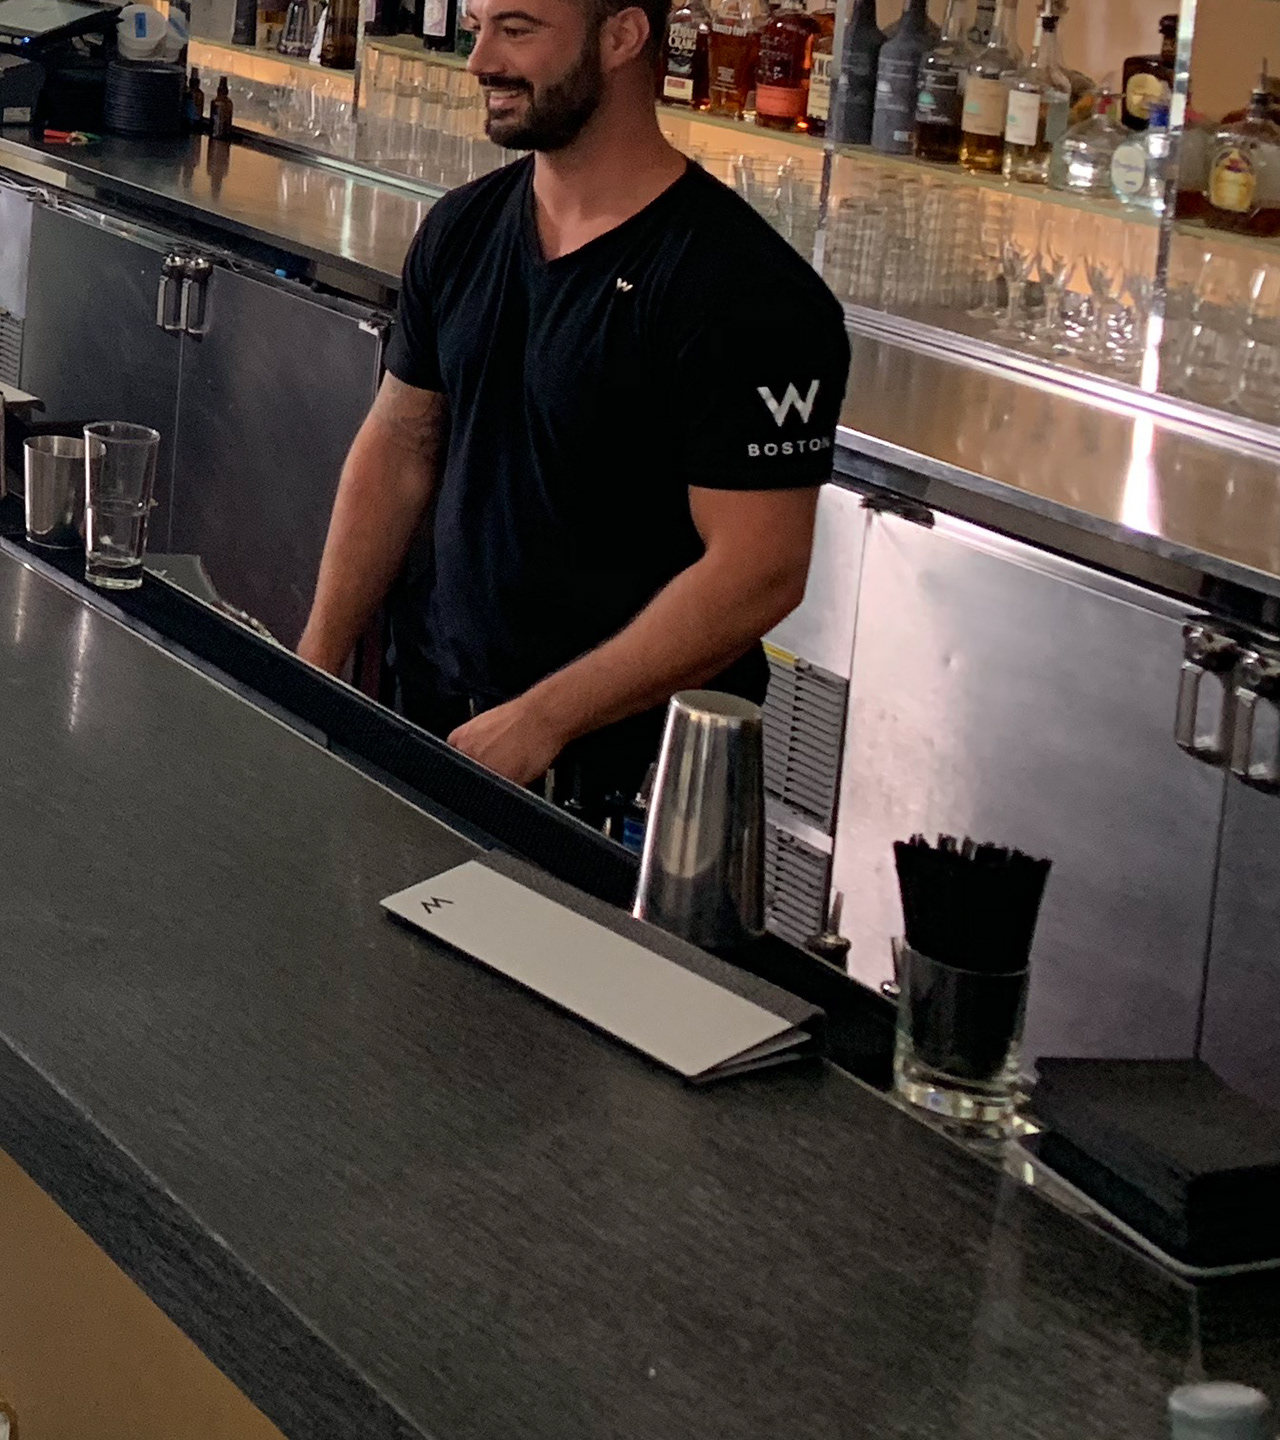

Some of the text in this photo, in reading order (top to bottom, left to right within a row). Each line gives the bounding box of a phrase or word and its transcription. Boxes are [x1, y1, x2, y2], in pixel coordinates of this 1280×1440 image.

[756, 378, 820, 427] W
[747, 437, 831, 458] BOSTON
[421, 895, 454, 915] W
